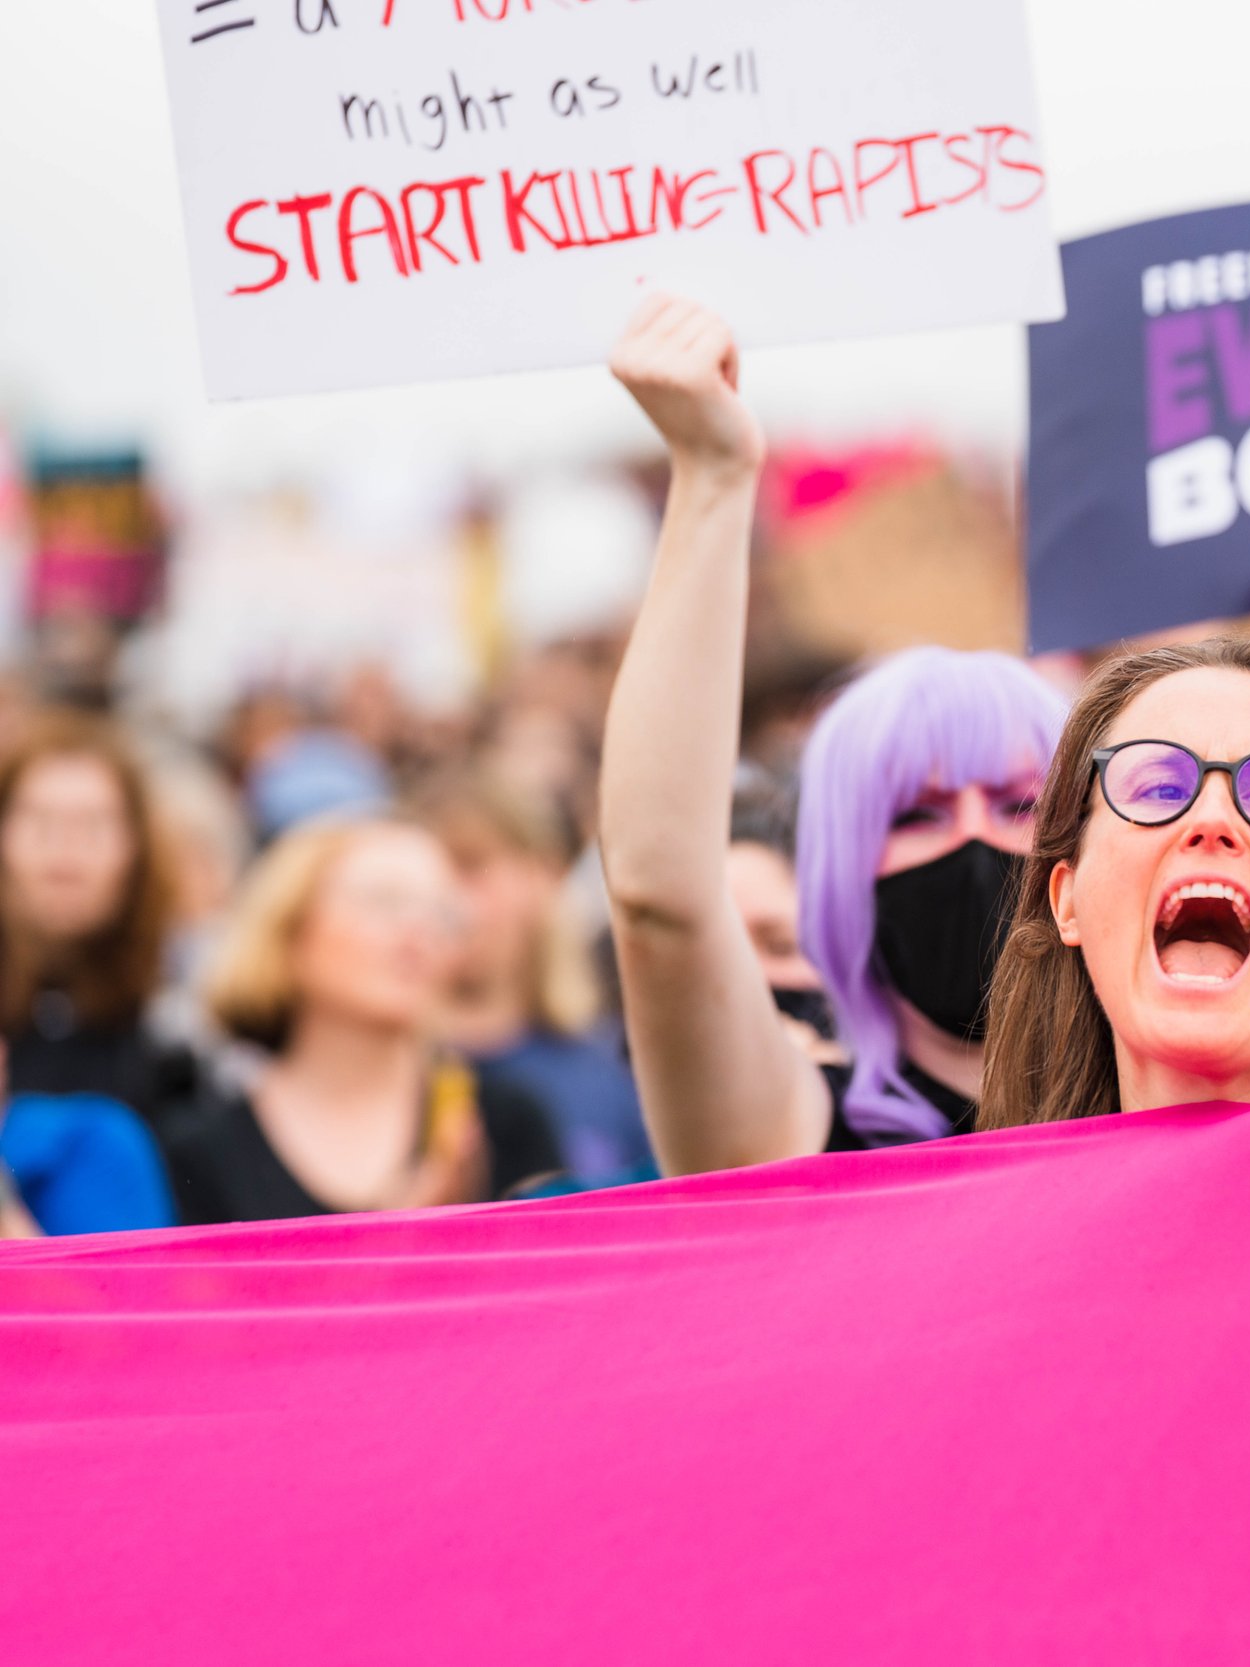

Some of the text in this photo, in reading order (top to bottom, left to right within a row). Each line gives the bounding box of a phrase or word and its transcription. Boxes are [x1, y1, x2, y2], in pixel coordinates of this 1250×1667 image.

[339, 48, 760, 151] might as well
[225, 175, 487, 297] START
[742, 124, 1046, 236] RAPISTS
